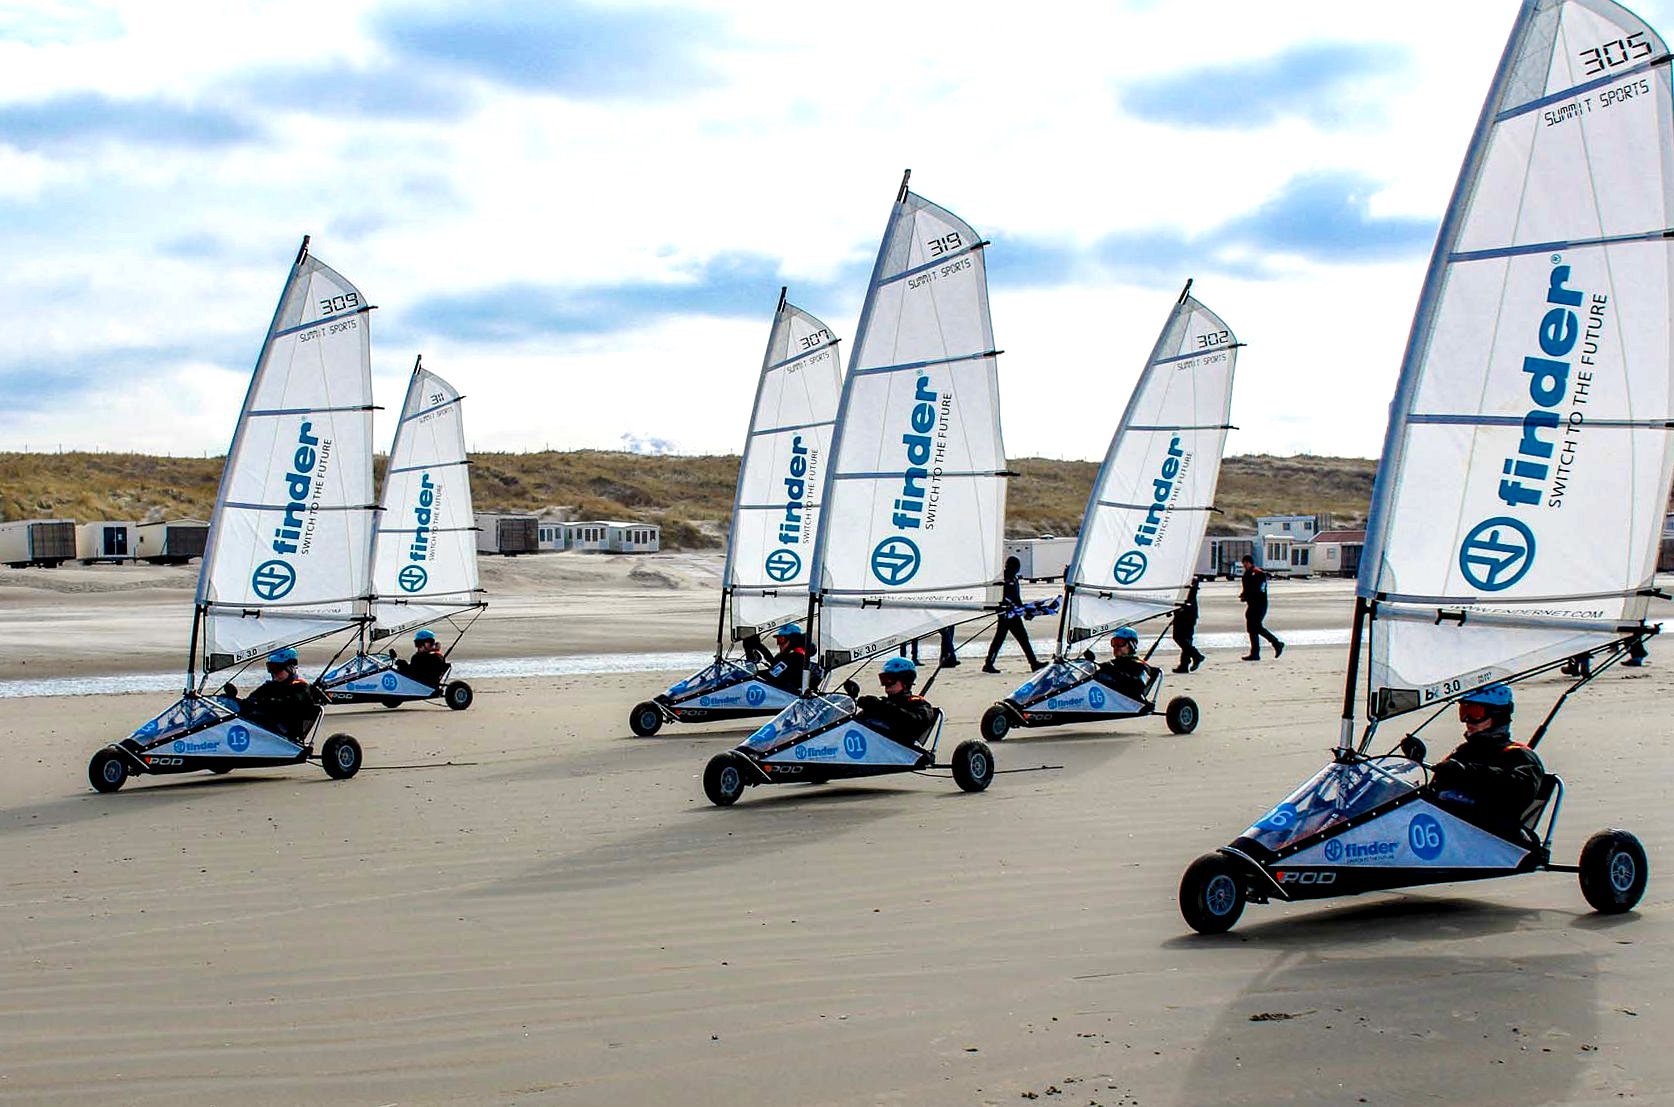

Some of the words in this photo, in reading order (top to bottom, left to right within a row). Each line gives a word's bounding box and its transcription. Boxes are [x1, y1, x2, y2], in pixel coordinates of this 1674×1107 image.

[1580, 31, 1653, 76] 305
[1544, 99, 1591, 127] SUMMIT
[1600, 79, 1650, 108] SPORTS
[927, 232, 962, 257] 319
[908, 271, 937, 290] SUMMIT
[940, 258, 971, 278] SPORTS
[320, 292, 359, 315] 309
[800, 329, 830, 350] 307
[1196, 330, 1229, 349] 302
[1581, 294, 1607, 365] FUTURE
[430, 393, 445, 405] 311
[1573, 371, 1593, 406] THE
[938, 393, 953, 439] FUTURE
[1566, 411, 1583, 435] TO
[317, 439, 332, 479] FUTURE
[934, 442, 947, 464] THE
[808, 449, 819, 481] FUTURE
[933, 467, 943, 483] TO
[1549, 440, 1577, 508] SWITCH
[313, 481, 324, 499] THE
[807, 483, 815, 499] THE
[1154, 515, 1170, 548] SWITCH
[1166, 502, 1175, 515] TO
[1171, 487, 1180, 504] THE
[1177, 452, 1193, 485] FUTURE
[310, 502, 319, 515] TO
[806, 500, 814, 512] TO
[925, 485, 940, 530] SWITCH
[301, 517, 317, 555] SWITCH
[803, 513, 811, 544] SWITCH
[247, 648, 258, 657] 3.0
[865, 644, 877, 654] 3.0
[384, 677, 395, 686] 03
[1443, 679, 1461, 695] 3.0
[749, 689, 763, 699] 07
[231, 731, 247, 746] 13
[846, 736, 864, 753] 01
[1413, 824, 1440, 849] 06
[1345, 841, 1399, 857] finder
